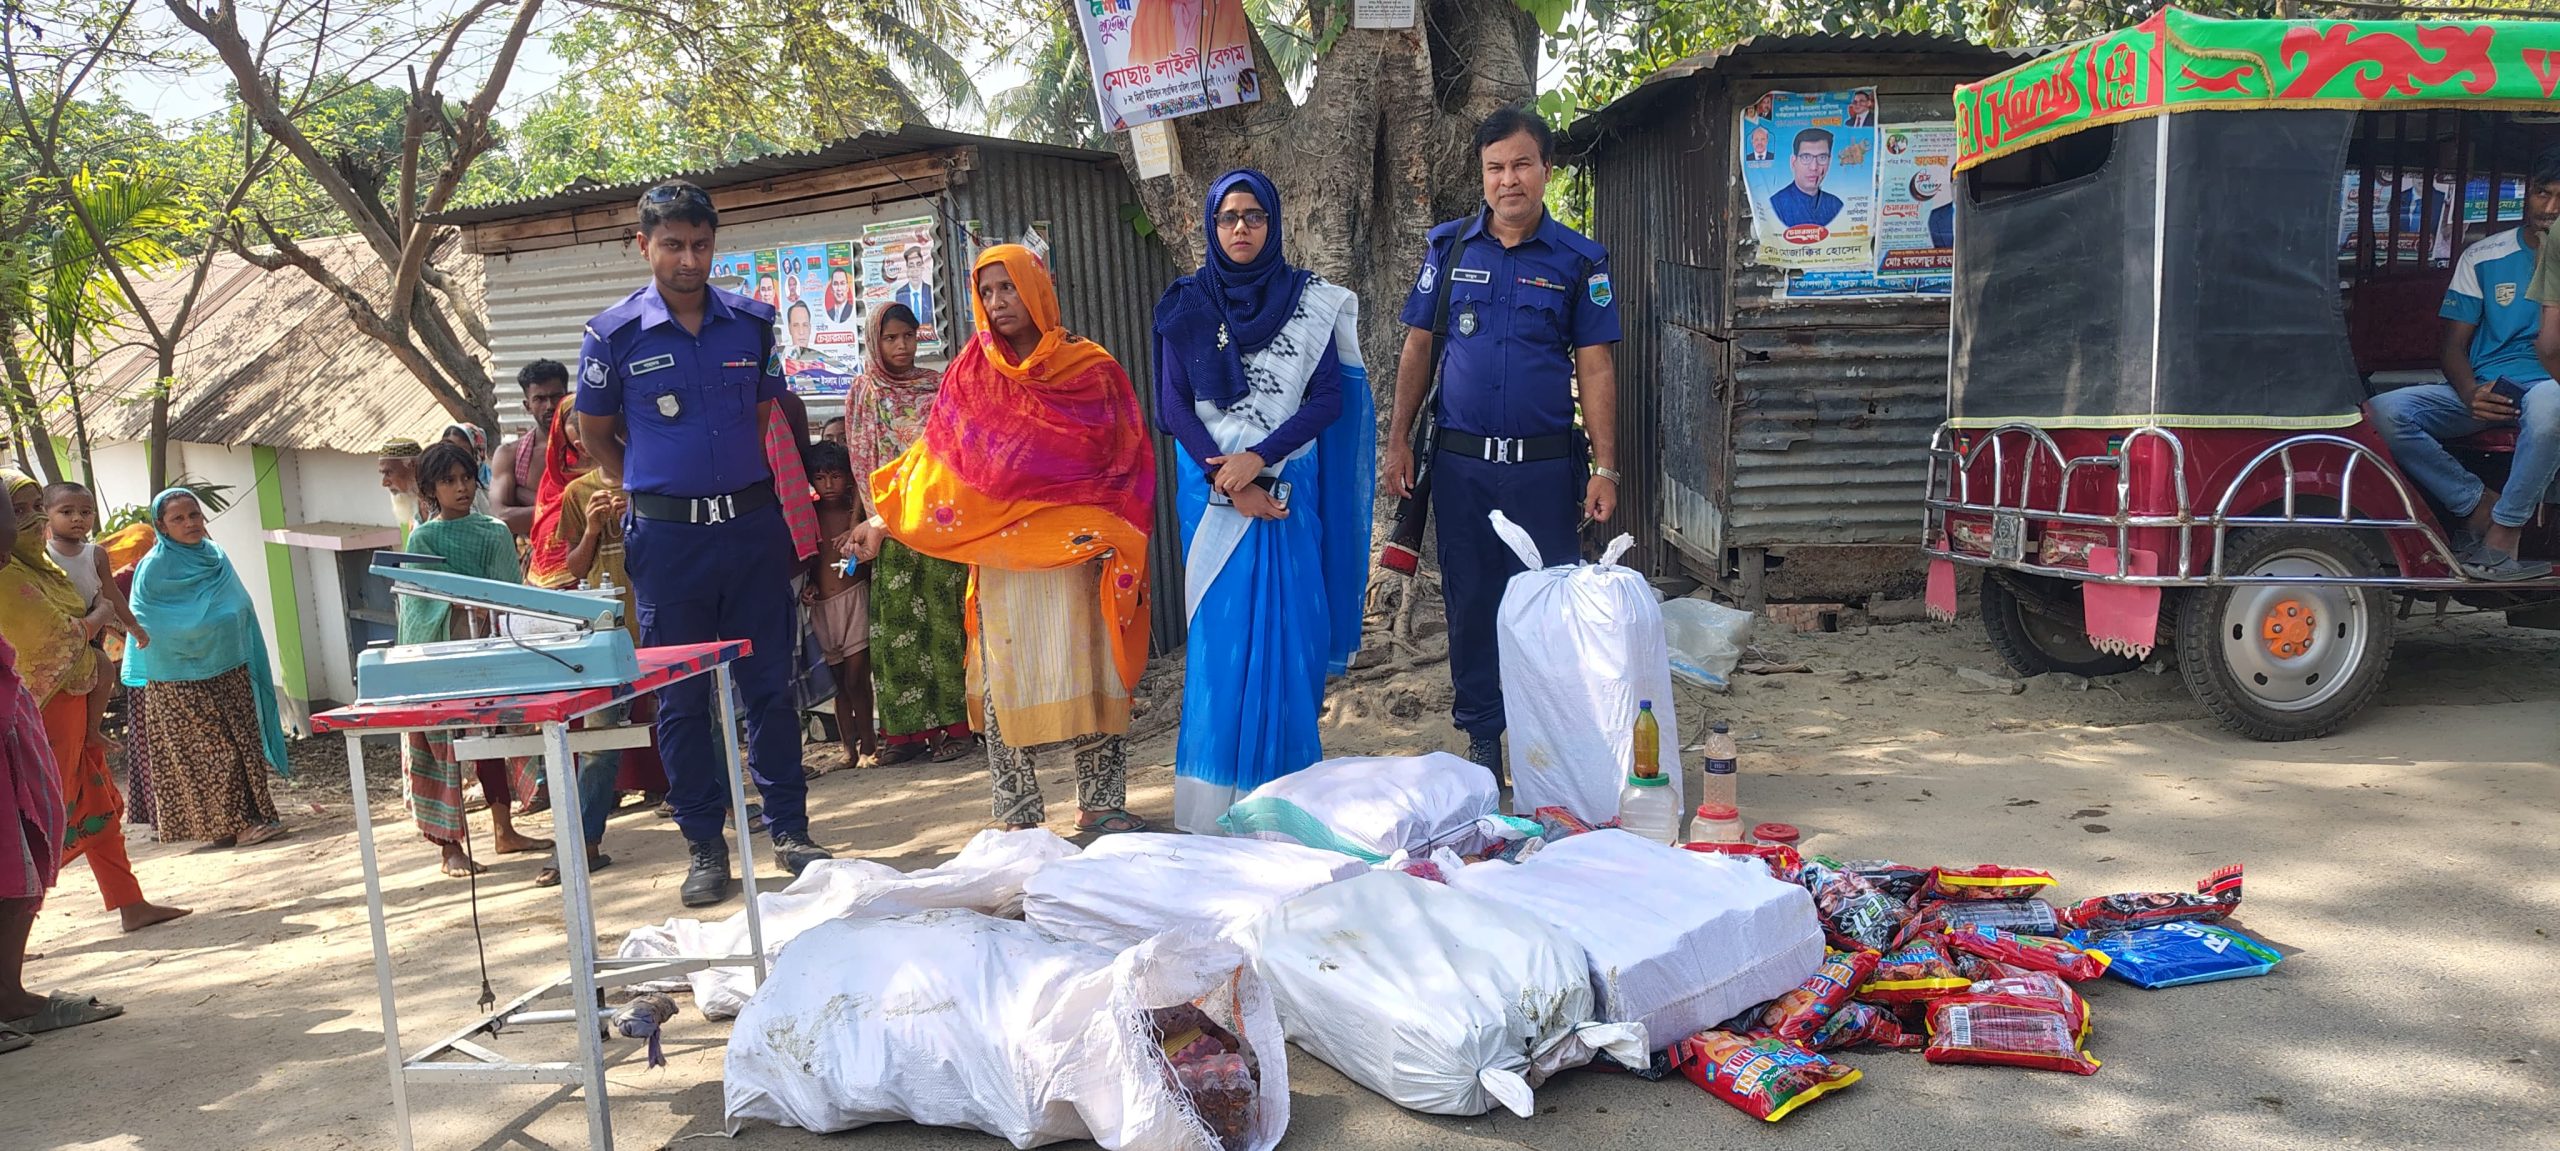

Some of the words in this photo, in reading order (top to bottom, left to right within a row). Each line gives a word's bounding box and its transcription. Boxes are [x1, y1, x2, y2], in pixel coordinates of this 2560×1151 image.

[1103, 63, 1151, 92] মোছাঃ
[1154, 47, 1201, 80] লাইলী
[1208, 44, 1246, 70] বেগম
[1826, 245, 1862, 257] হোসেন
